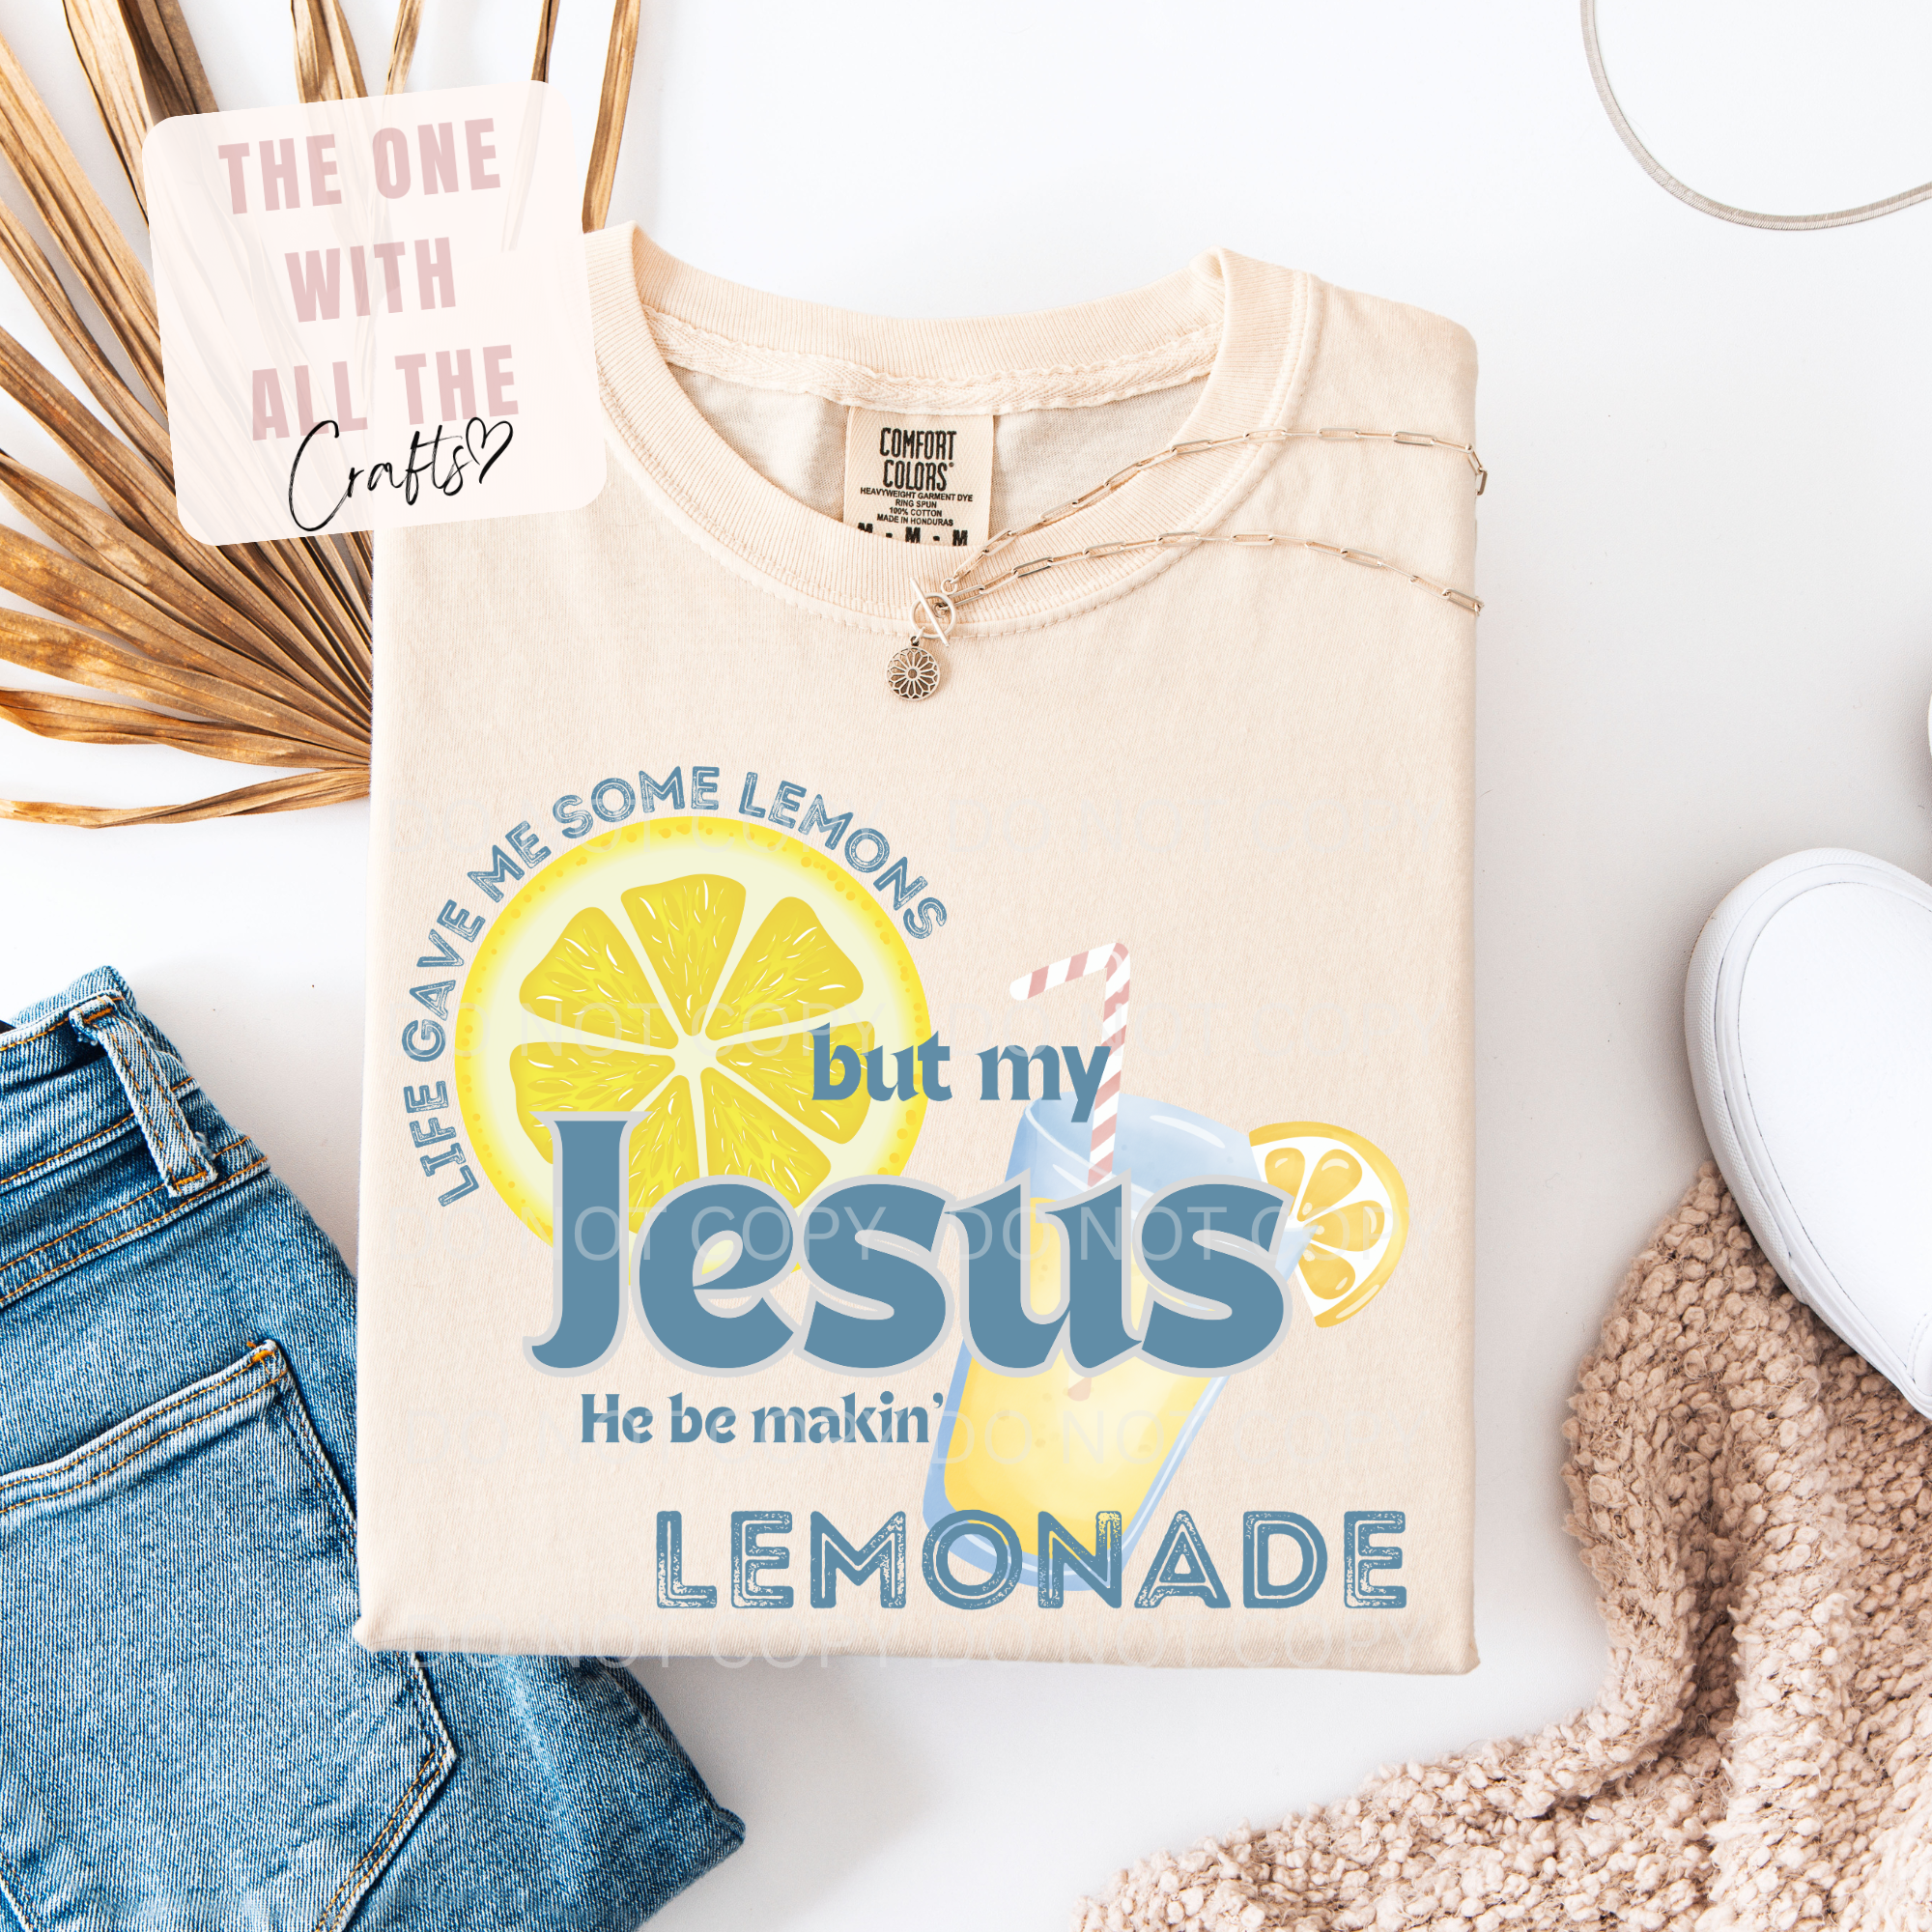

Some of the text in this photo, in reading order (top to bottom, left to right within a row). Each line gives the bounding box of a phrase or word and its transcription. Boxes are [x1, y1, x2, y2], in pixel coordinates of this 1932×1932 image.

[880, 427, 957, 461] COMFORT
[860, 487, 974, 502] HEAVYWEIGHT GARMENT DYE
[895, 498, 937, 509] RING SPUN
[877, 514, 954, 526] MADE IN HONDURAS
[890, 506, 943, 518] 100% COTTON
[905, 526, 922, 544] M
[952, 529, 969, 547] M
[401, 765, 948, 1208] LIFE GAVE ME SOME LEMONS
[807, 1022, 1112, 1123] but my
[523, 1111, 1298, 1378] Jesus
[581, 1392, 654, 1444] He
[668, 1391, 737, 1444] be
[656, 1509, 1407, 1610] LEMONADE
